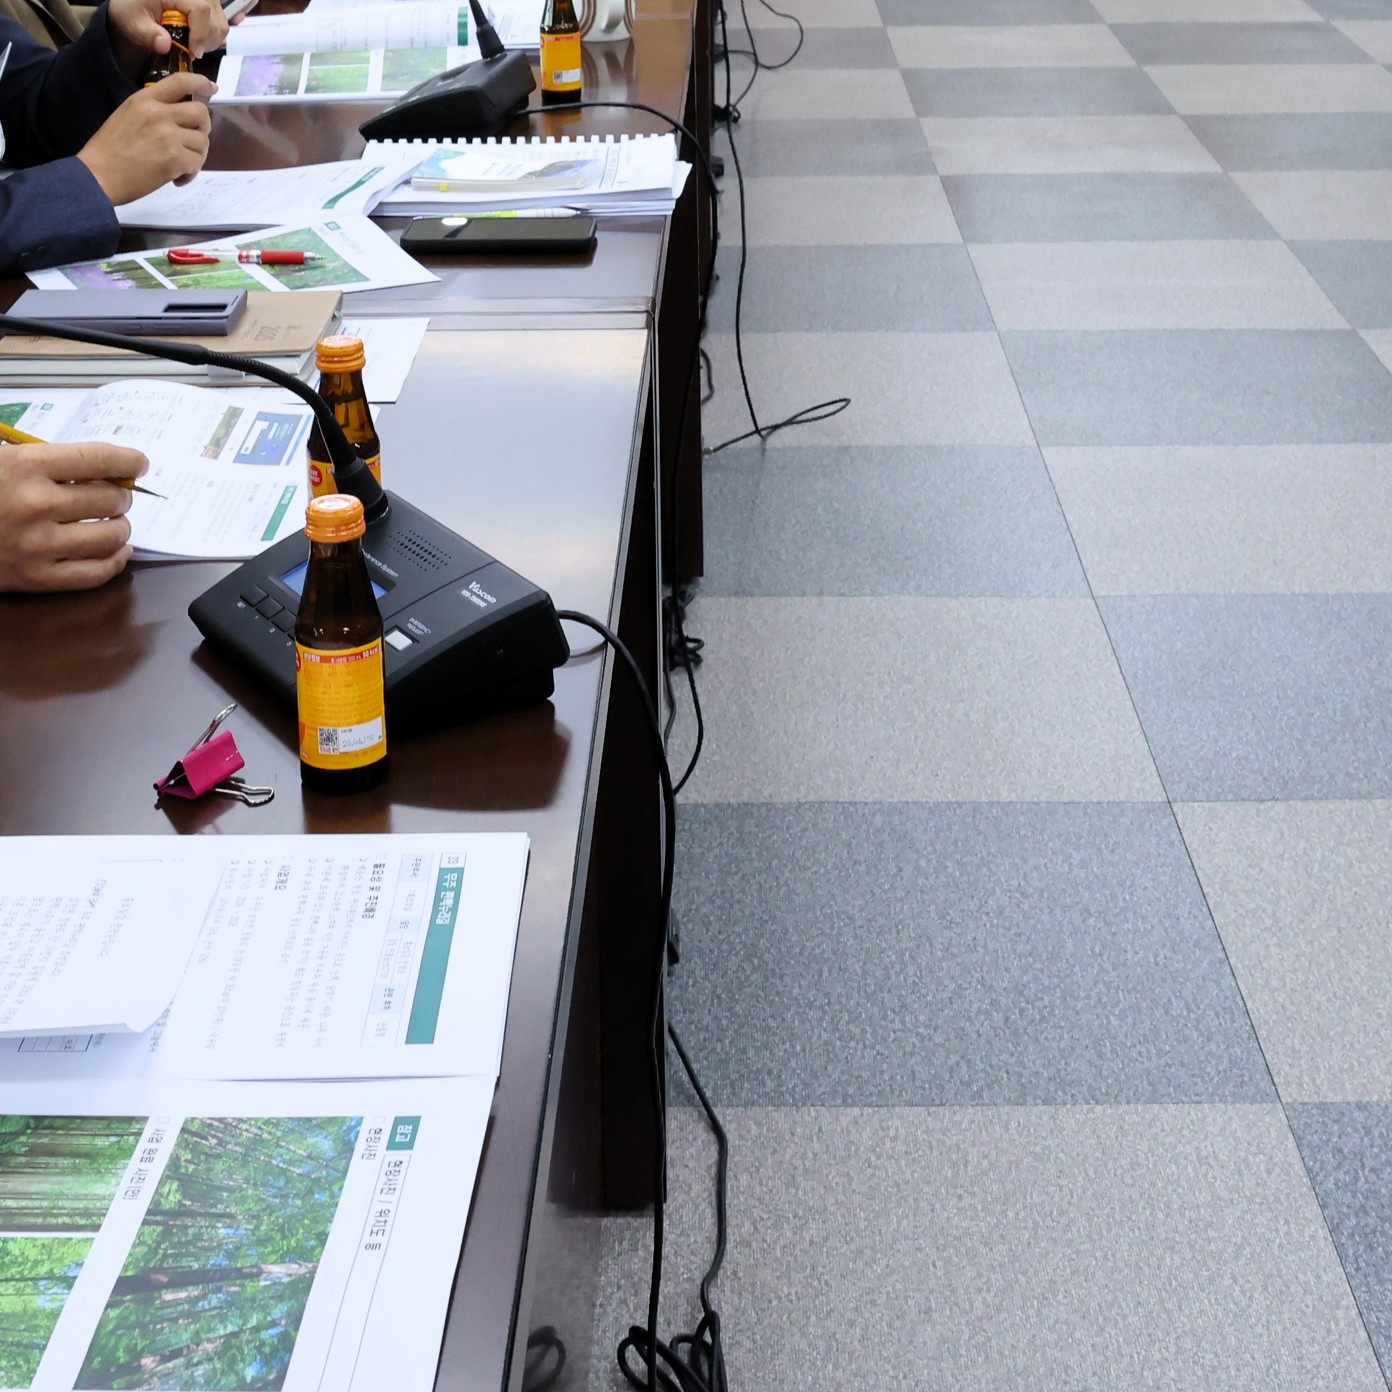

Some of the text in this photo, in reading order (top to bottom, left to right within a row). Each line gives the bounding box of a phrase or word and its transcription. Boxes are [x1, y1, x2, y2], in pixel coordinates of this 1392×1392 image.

[274, 864, 289, 892] 사업개요
[442, 872, 458, 888] 무주
[362, 862, 386, 920] 필요성 및 추진배경
[147, 1128, 167, 1144] 사업
[361, 1127, 383, 1161] 현장사진
[395, 1124, 413, 1143] 참고
[139, 1148, 159, 1164] 완료
[380, 1159, 403, 1196] 현장사진
[369, 1208, 391, 1237] 위치도
[364, 1242, 382, 1252] 등
